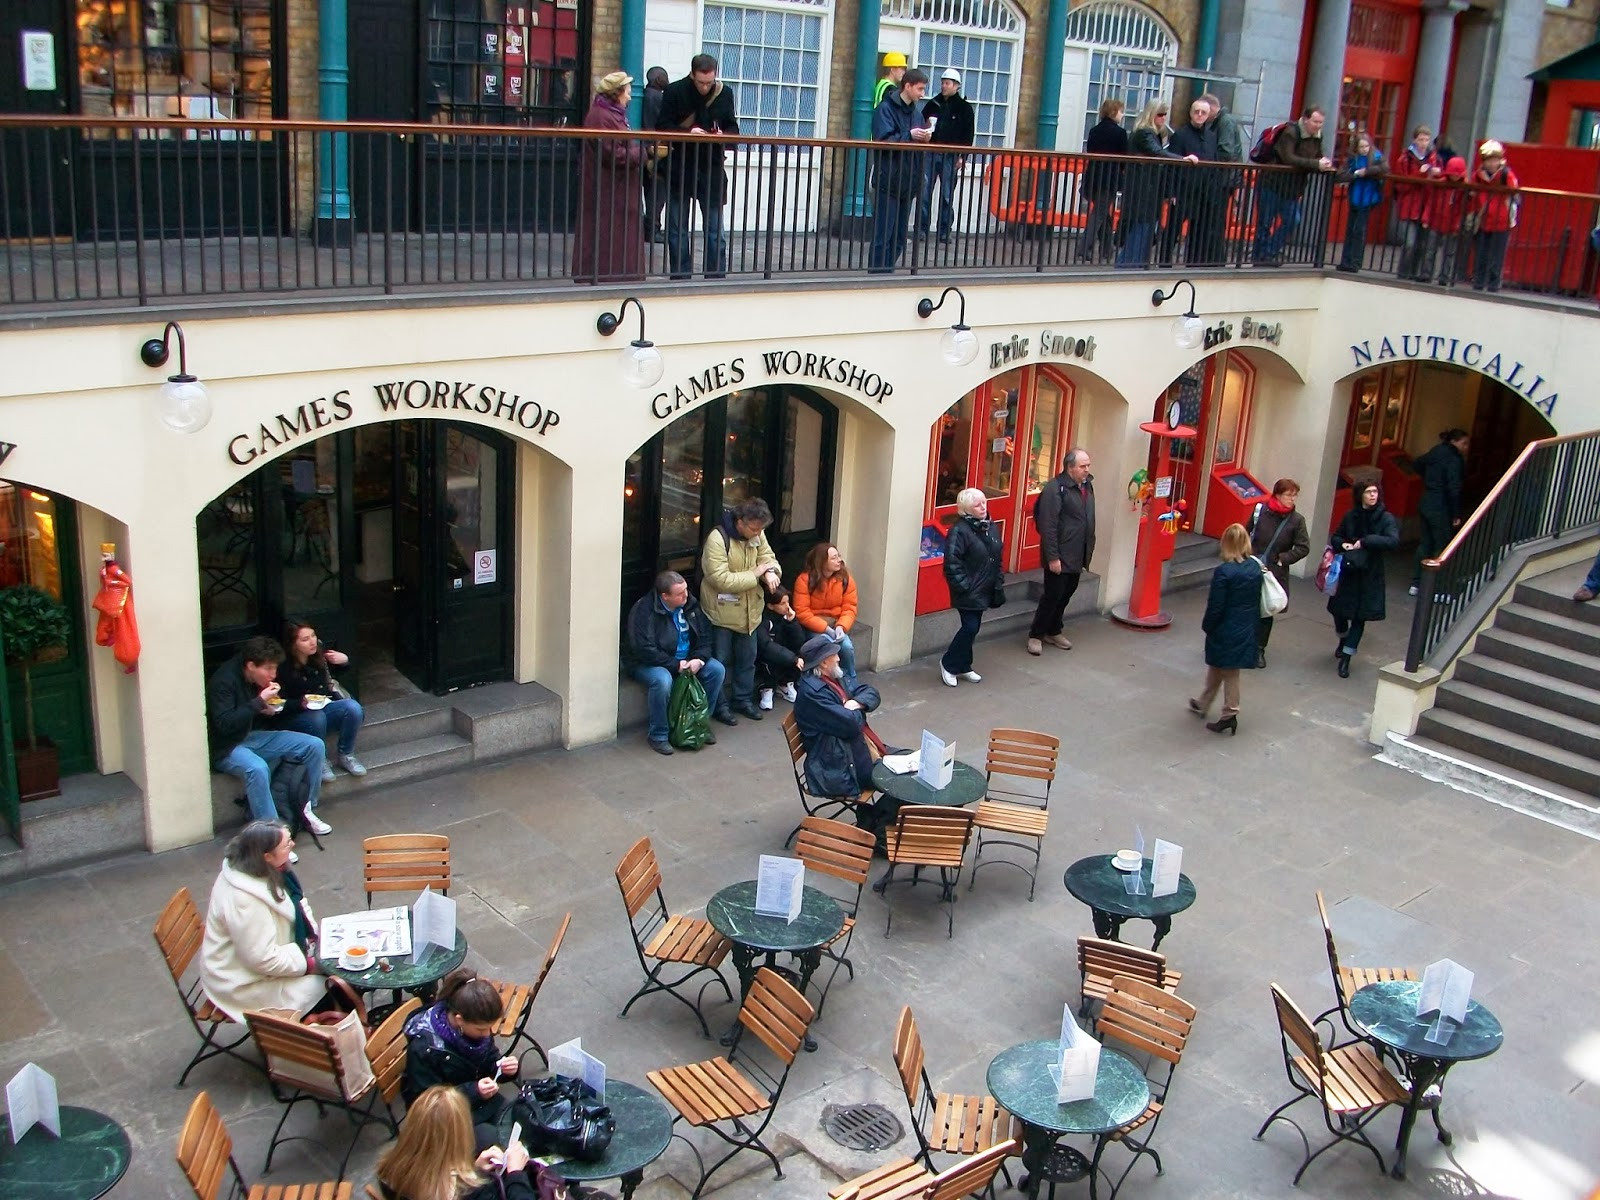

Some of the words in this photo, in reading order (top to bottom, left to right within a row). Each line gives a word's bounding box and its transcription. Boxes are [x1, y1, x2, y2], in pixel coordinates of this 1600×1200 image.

[989, 334, 1030, 370] Eric
[1040, 329, 1098, 362] Snook
[1203, 320, 1233, 351] Eric
[651, 357, 745, 420] GAMES
[762, 350, 894, 405] WORKSHOP
[1350, 335, 1560, 417] NAUTICALIA
[228, 389, 354, 466] GAMES
[373, 379, 561, 437] WORKSHOP
